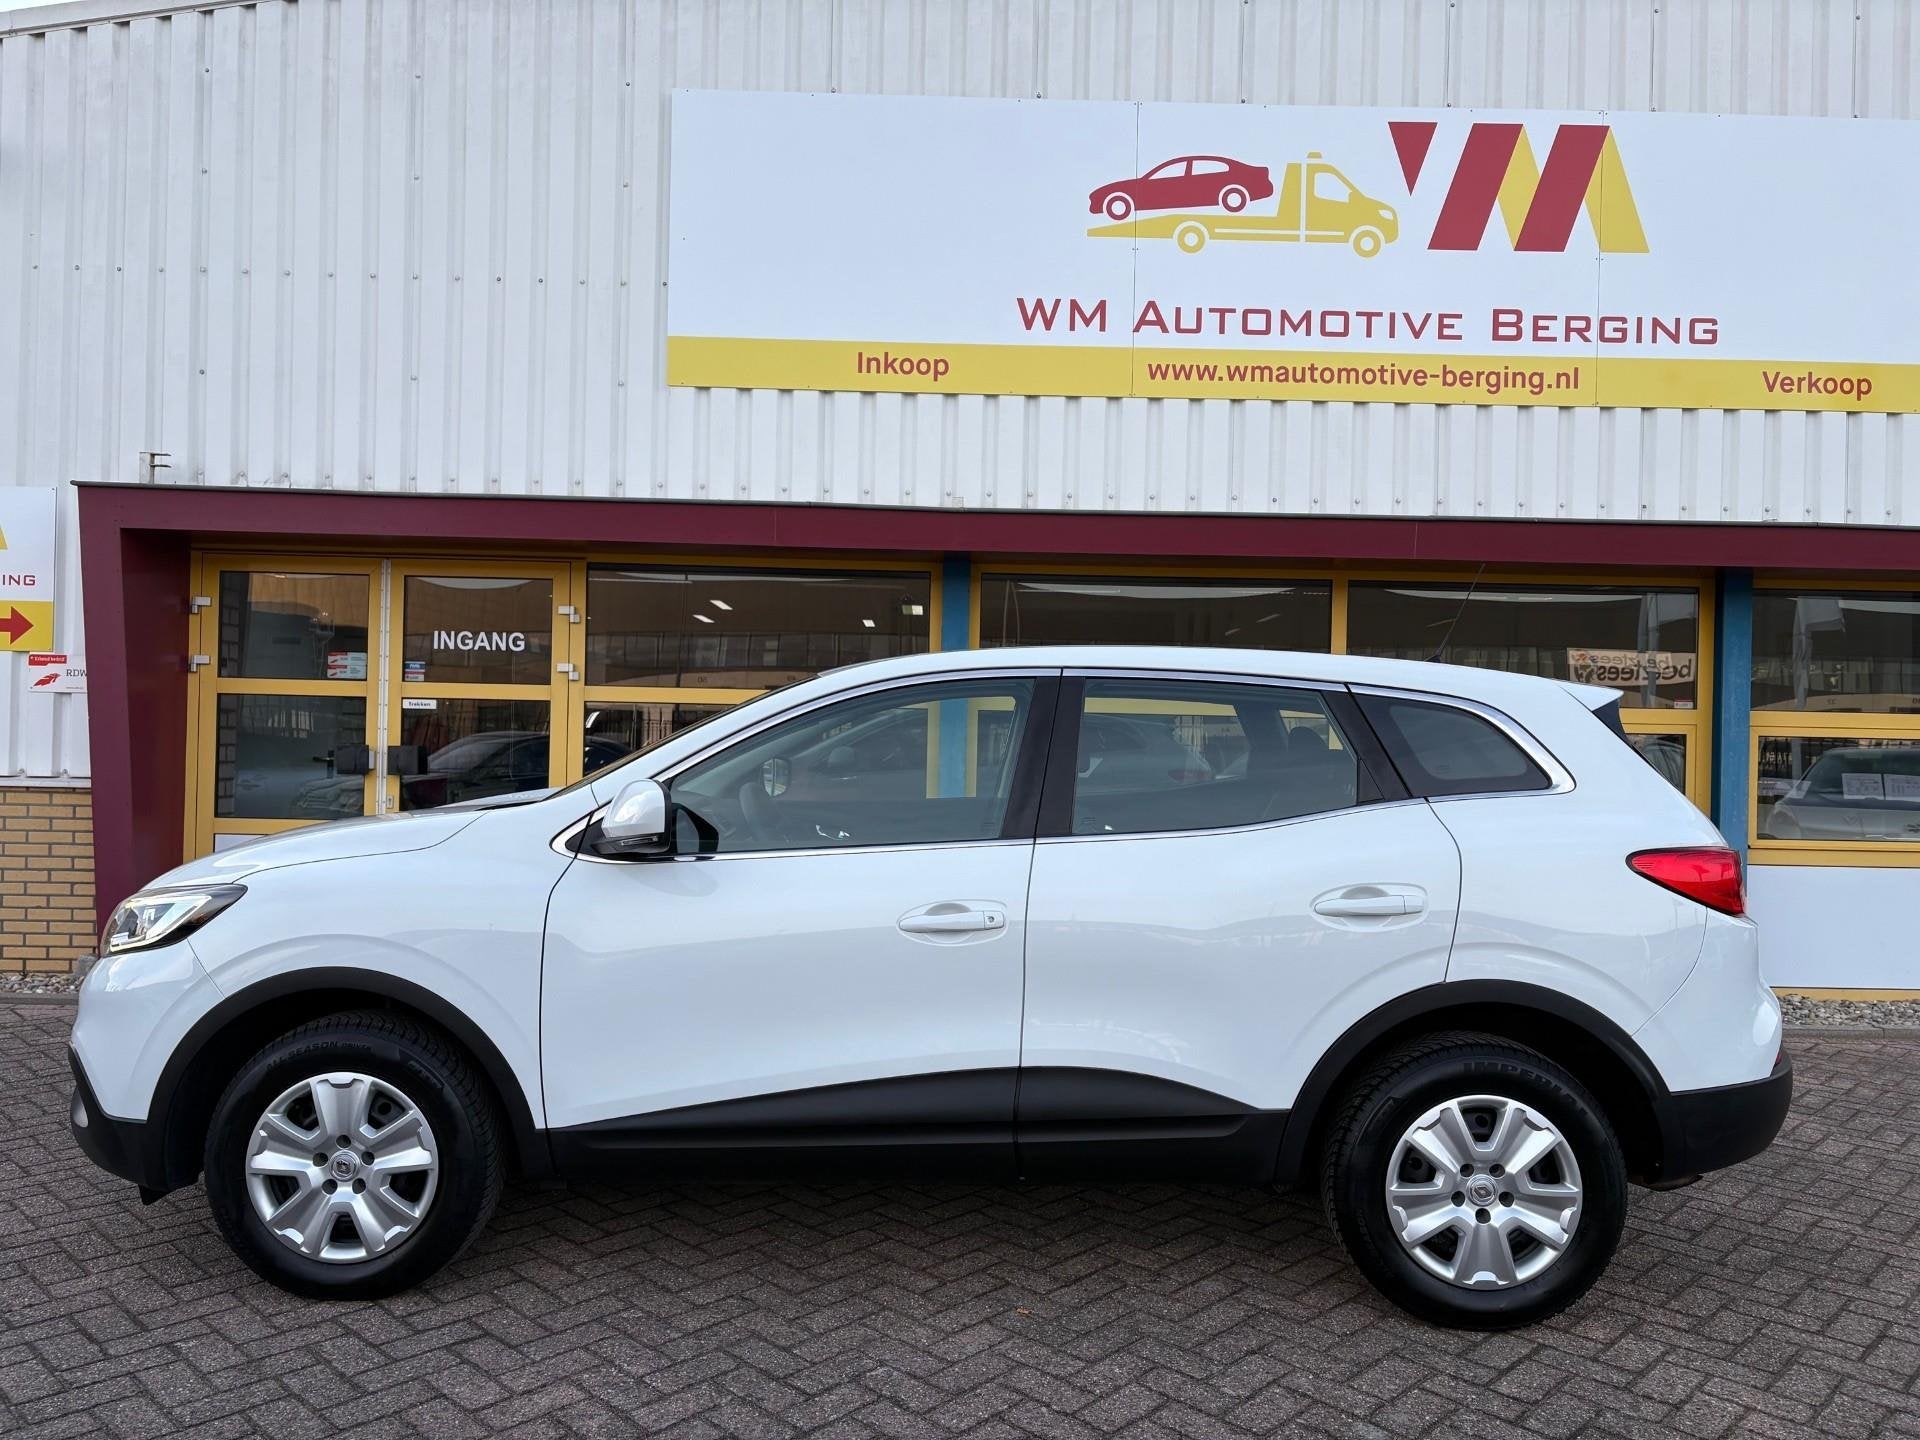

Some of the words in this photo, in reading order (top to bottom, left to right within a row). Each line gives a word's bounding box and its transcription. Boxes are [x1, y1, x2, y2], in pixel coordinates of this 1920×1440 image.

[1017, 298, 1107, 332] WM
[857, 351, 950, 382] Inkoop
[1147, 363, 1579, 396] www.wmautomotive-berging.nl
[1762, 372, 1873, 401] Verkoop
[433, 630, 526, 652] INGANG
[66, 669, 87, 677] RDW
